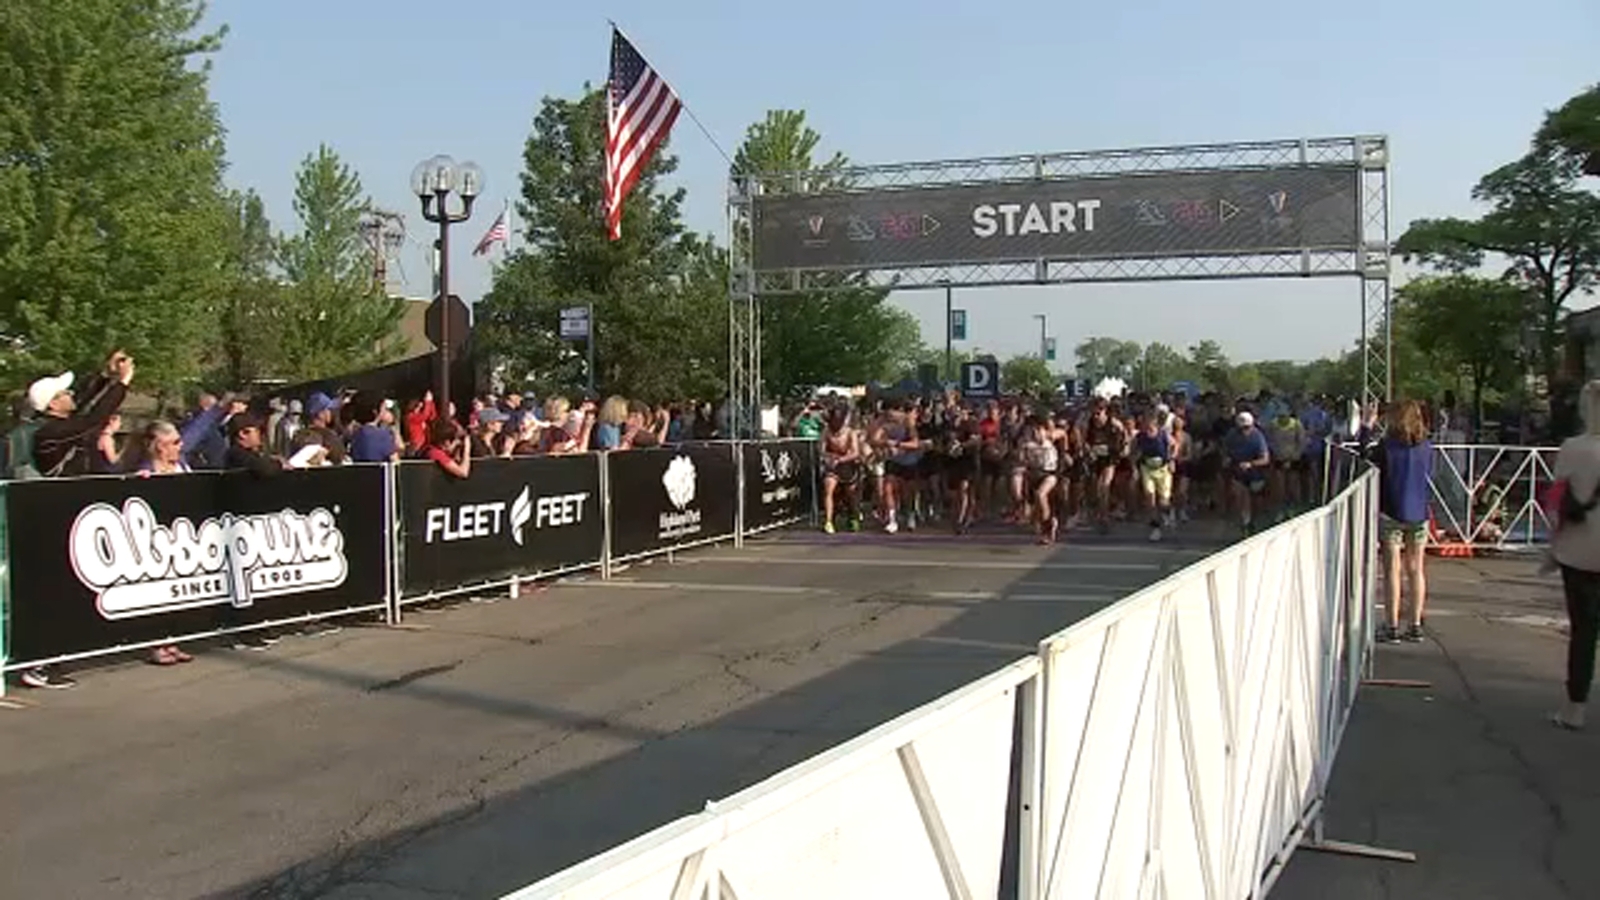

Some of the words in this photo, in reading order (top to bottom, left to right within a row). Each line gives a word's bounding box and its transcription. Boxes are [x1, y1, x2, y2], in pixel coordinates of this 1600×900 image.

[972, 199, 1101, 238] START
[969, 364, 990, 389] D
[1073, 380, 1084, 396] E
[426, 501, 505, 544] FLEET
[536, 492, 588, 529] FEET
[170, 577, 222, 598] SINCE
[259, 569, 304, 587] 1908
